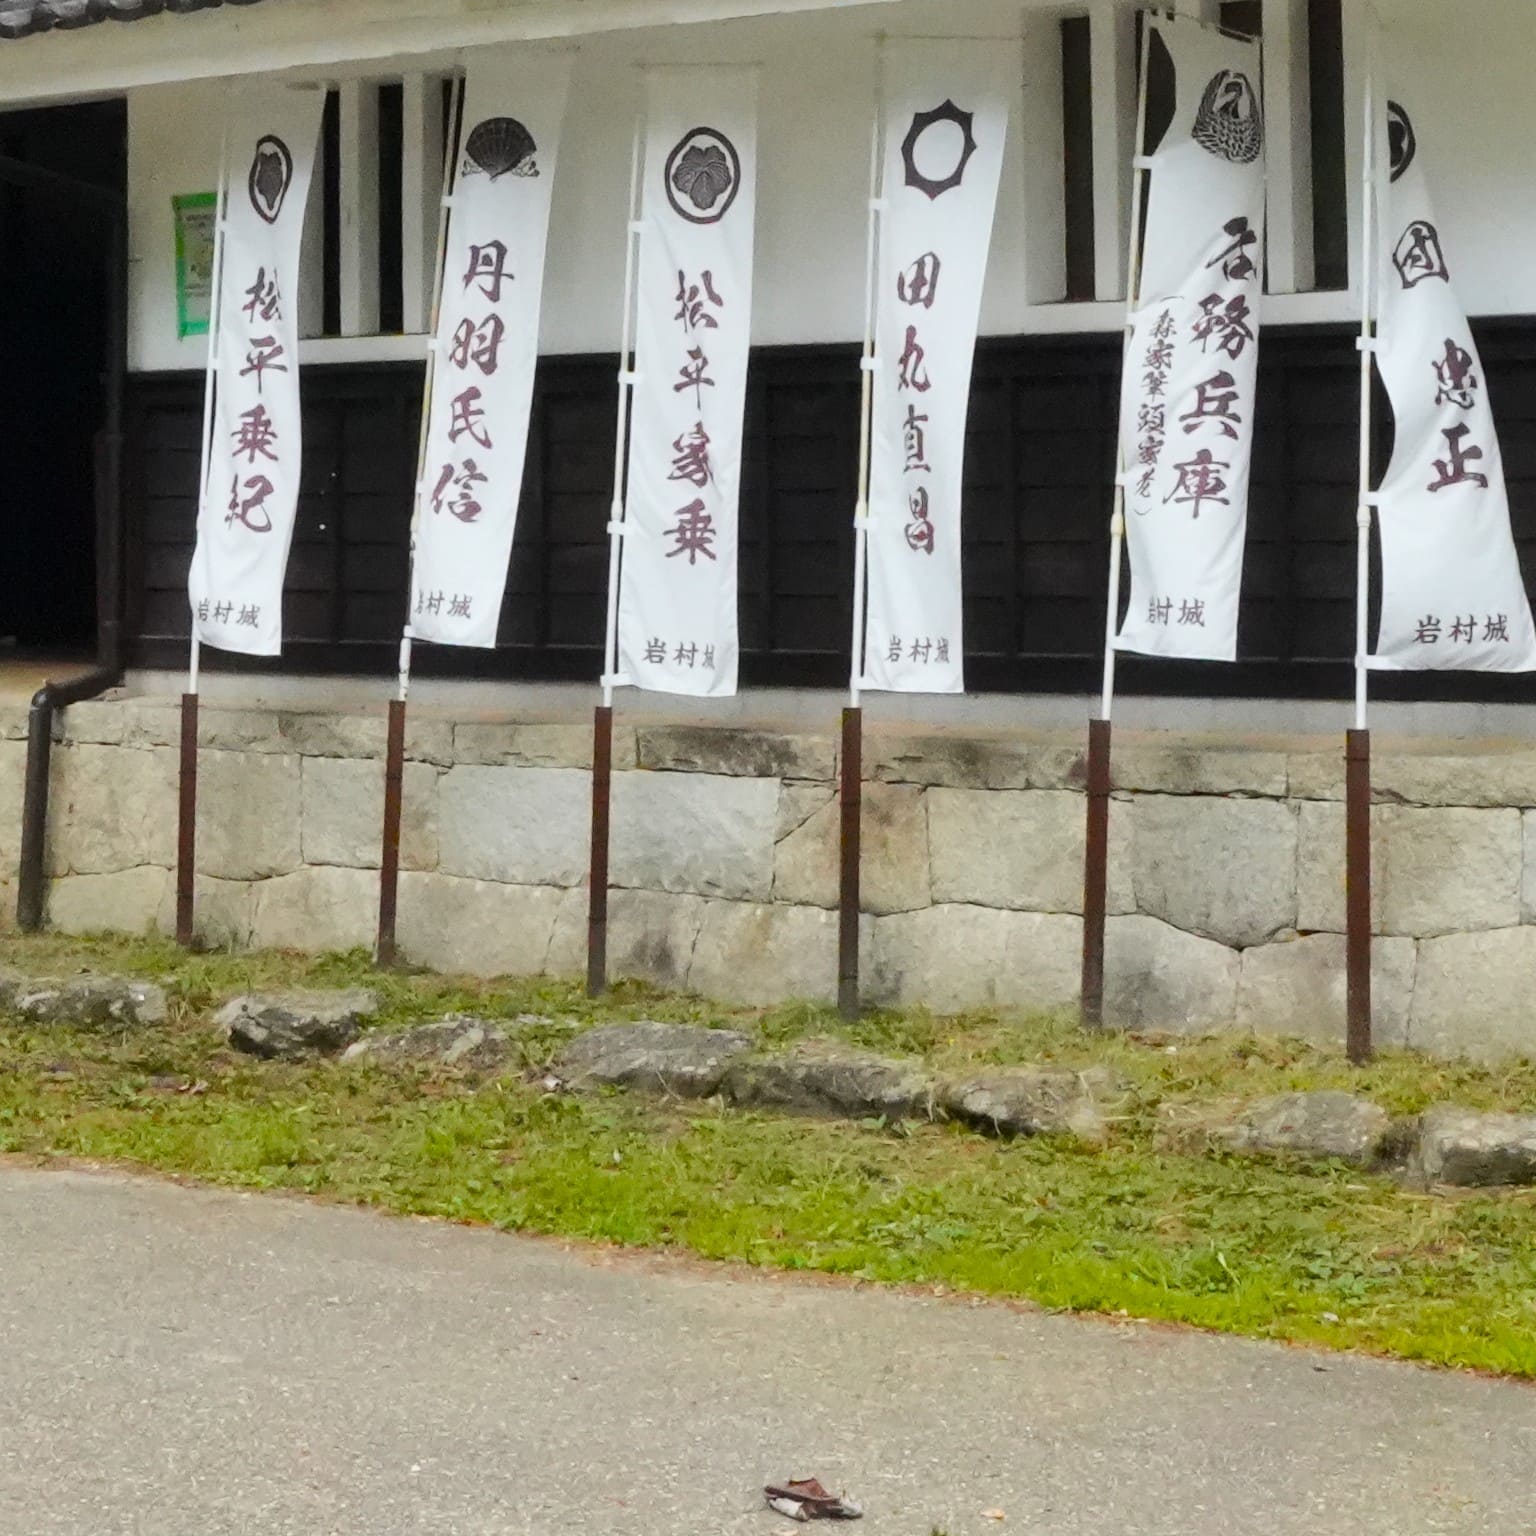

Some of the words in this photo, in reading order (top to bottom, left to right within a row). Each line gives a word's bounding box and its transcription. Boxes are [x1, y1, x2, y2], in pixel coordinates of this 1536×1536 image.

[224, 266, 288, 533] 松平乗紀
[430, 239, 515, 524] 丹羽氏信
[661, 268, 724, 566] 松平家乗
[197, 597, 261, 629] 岩村城
[886, 634, 950, 665] 岩村城
[1412, 613, 1510, 646] 岩村城
